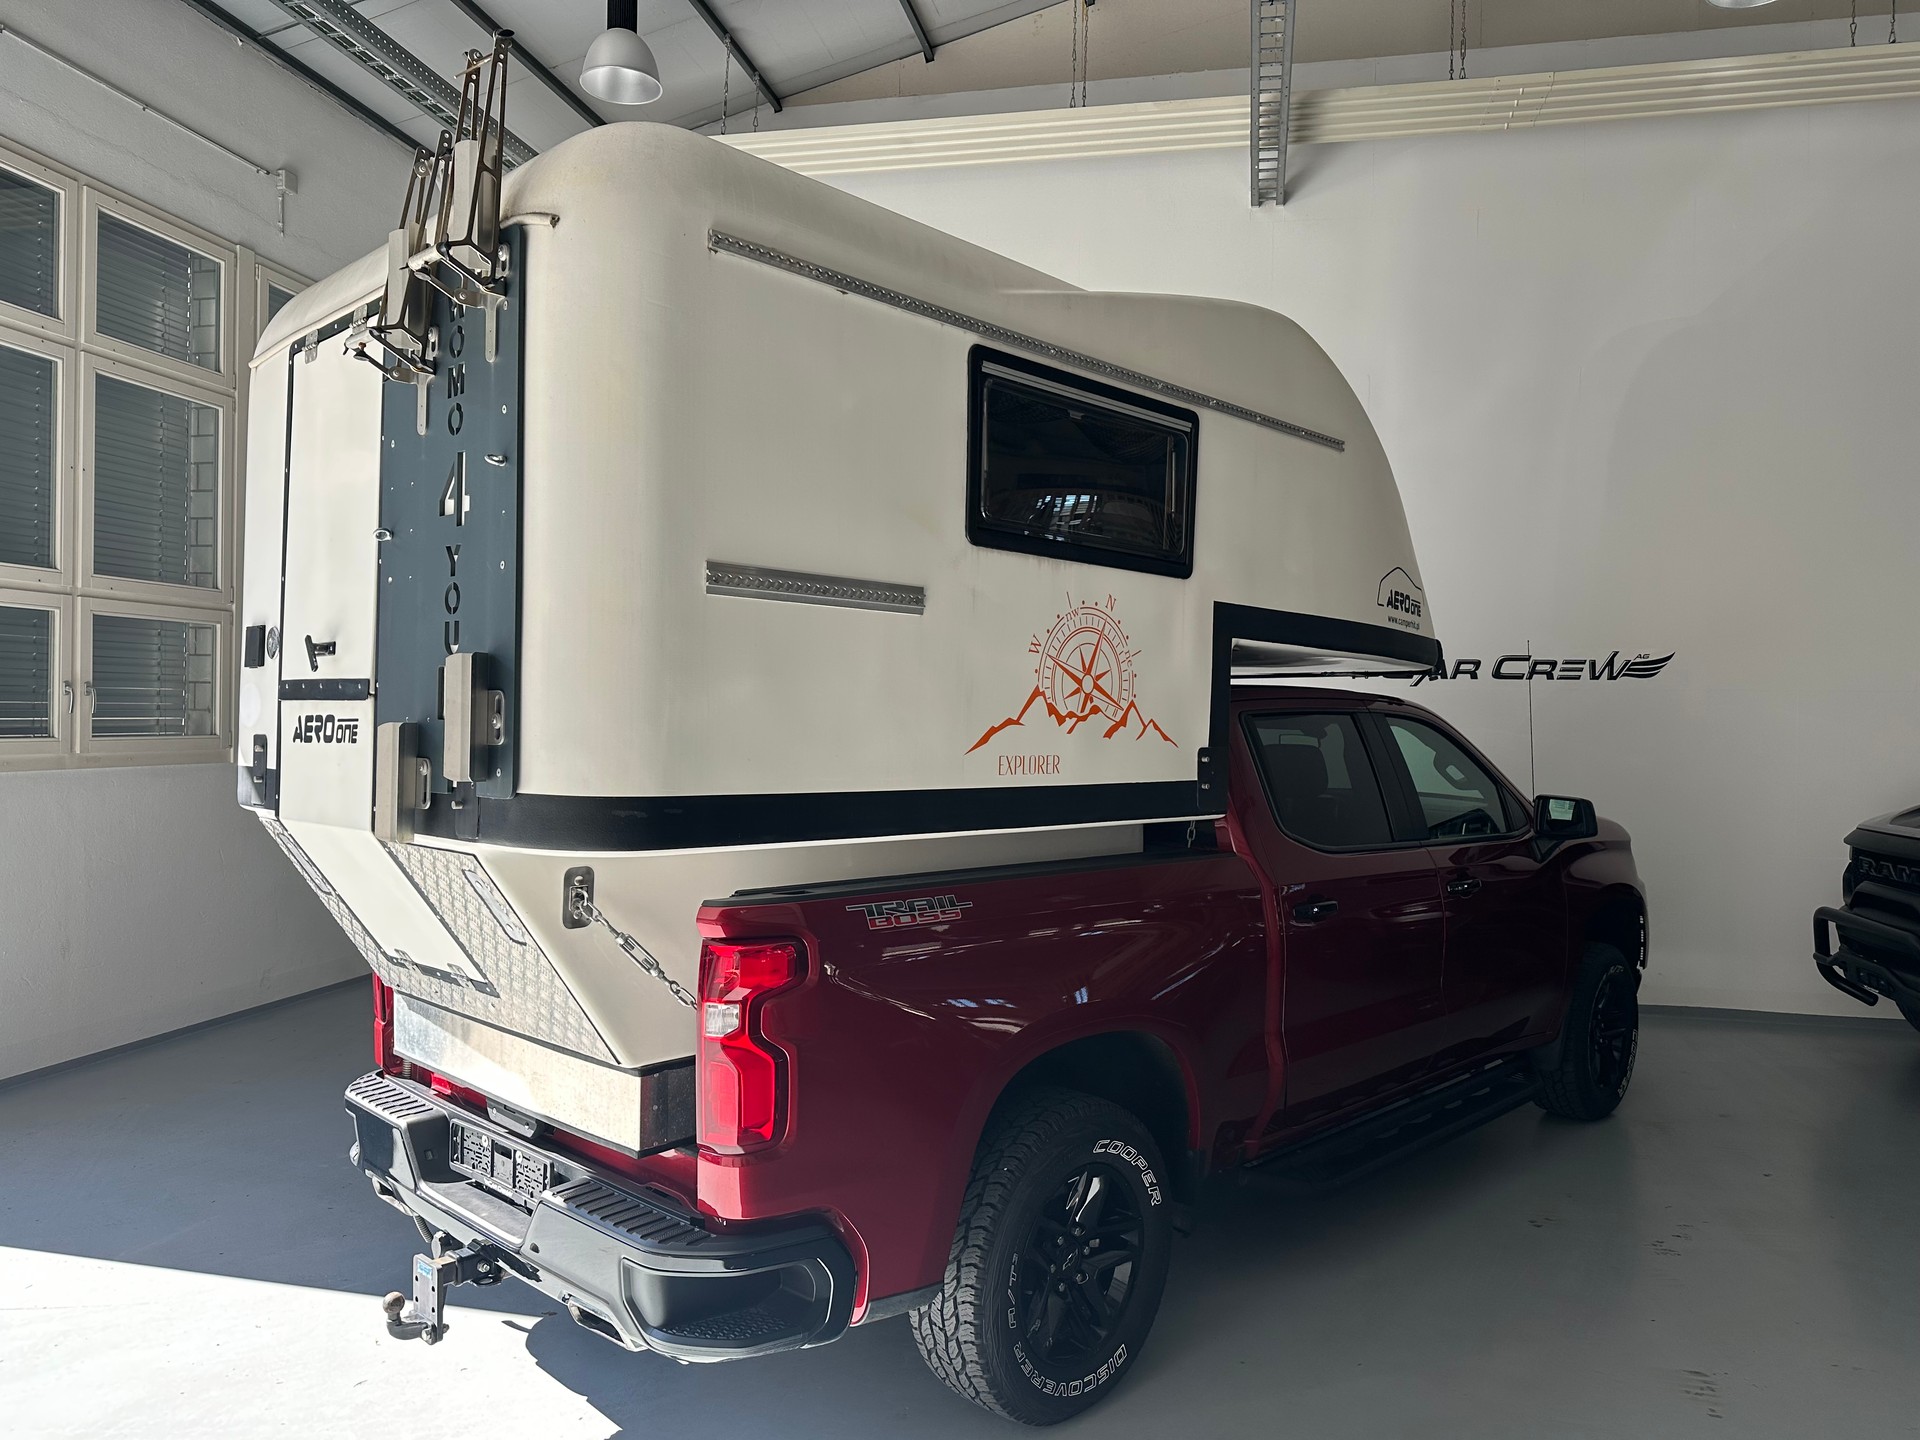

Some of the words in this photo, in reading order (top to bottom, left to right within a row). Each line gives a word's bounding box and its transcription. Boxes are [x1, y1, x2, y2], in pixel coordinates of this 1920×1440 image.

[439, 451, 471, 527] 4
[444, 543, 462, 654] YOU
[1105, 593, 1117, 612] N
[1387, 588, 1410, 614] AERO
[1028, 634, 1042, 655] W
[1491, 651, 1631, 681] CREW
[292, 713, 335, 744] AERO
[998, 754, 1061, 776] EXPLORER
[845, 894, 973, 918] TRAIL
[868, 908, 962, 931] BOSS
[1093, 1139, 1162, 1206] COOPER
[1013, 1341, 1128, 1397] DISCOVERER
